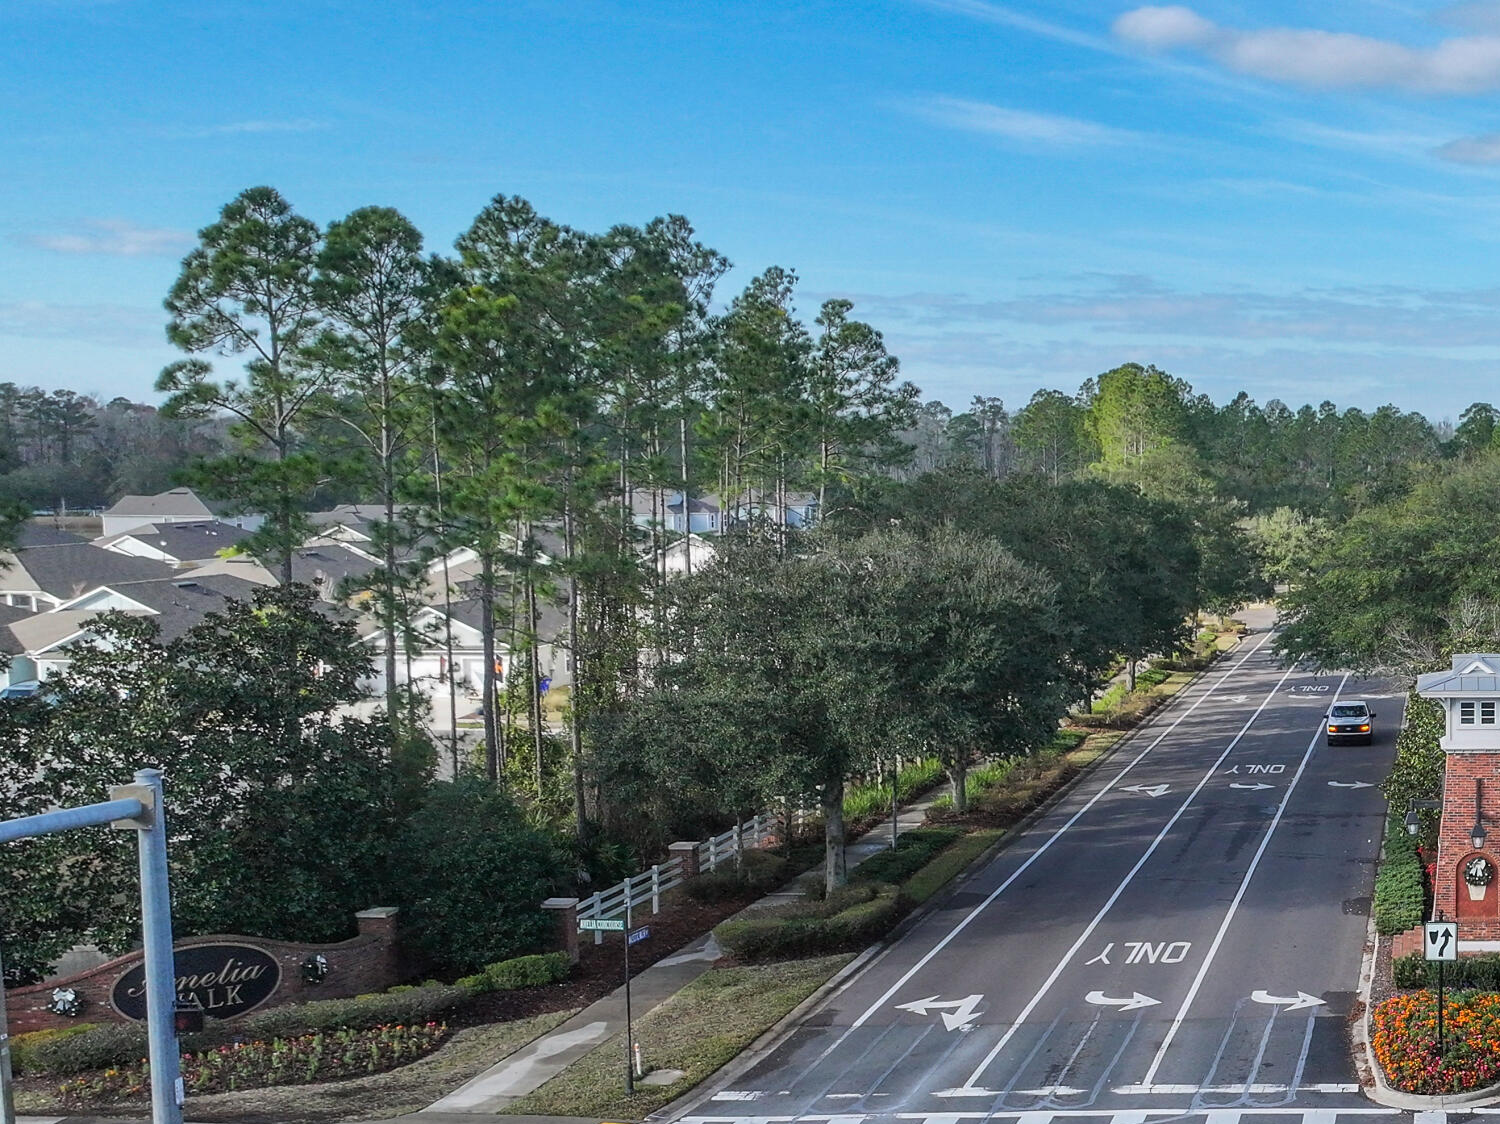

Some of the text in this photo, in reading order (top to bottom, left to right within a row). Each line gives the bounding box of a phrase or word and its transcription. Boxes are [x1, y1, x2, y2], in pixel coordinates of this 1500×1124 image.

[1286, 685, 1329, 693] ONLY
[1224, 763, 1286, 775] ONLY
[1084, 942, 1192, 965] ONLY
[127, 958, 269, 997] melia
[179, 984, 243, 1010] ALK
